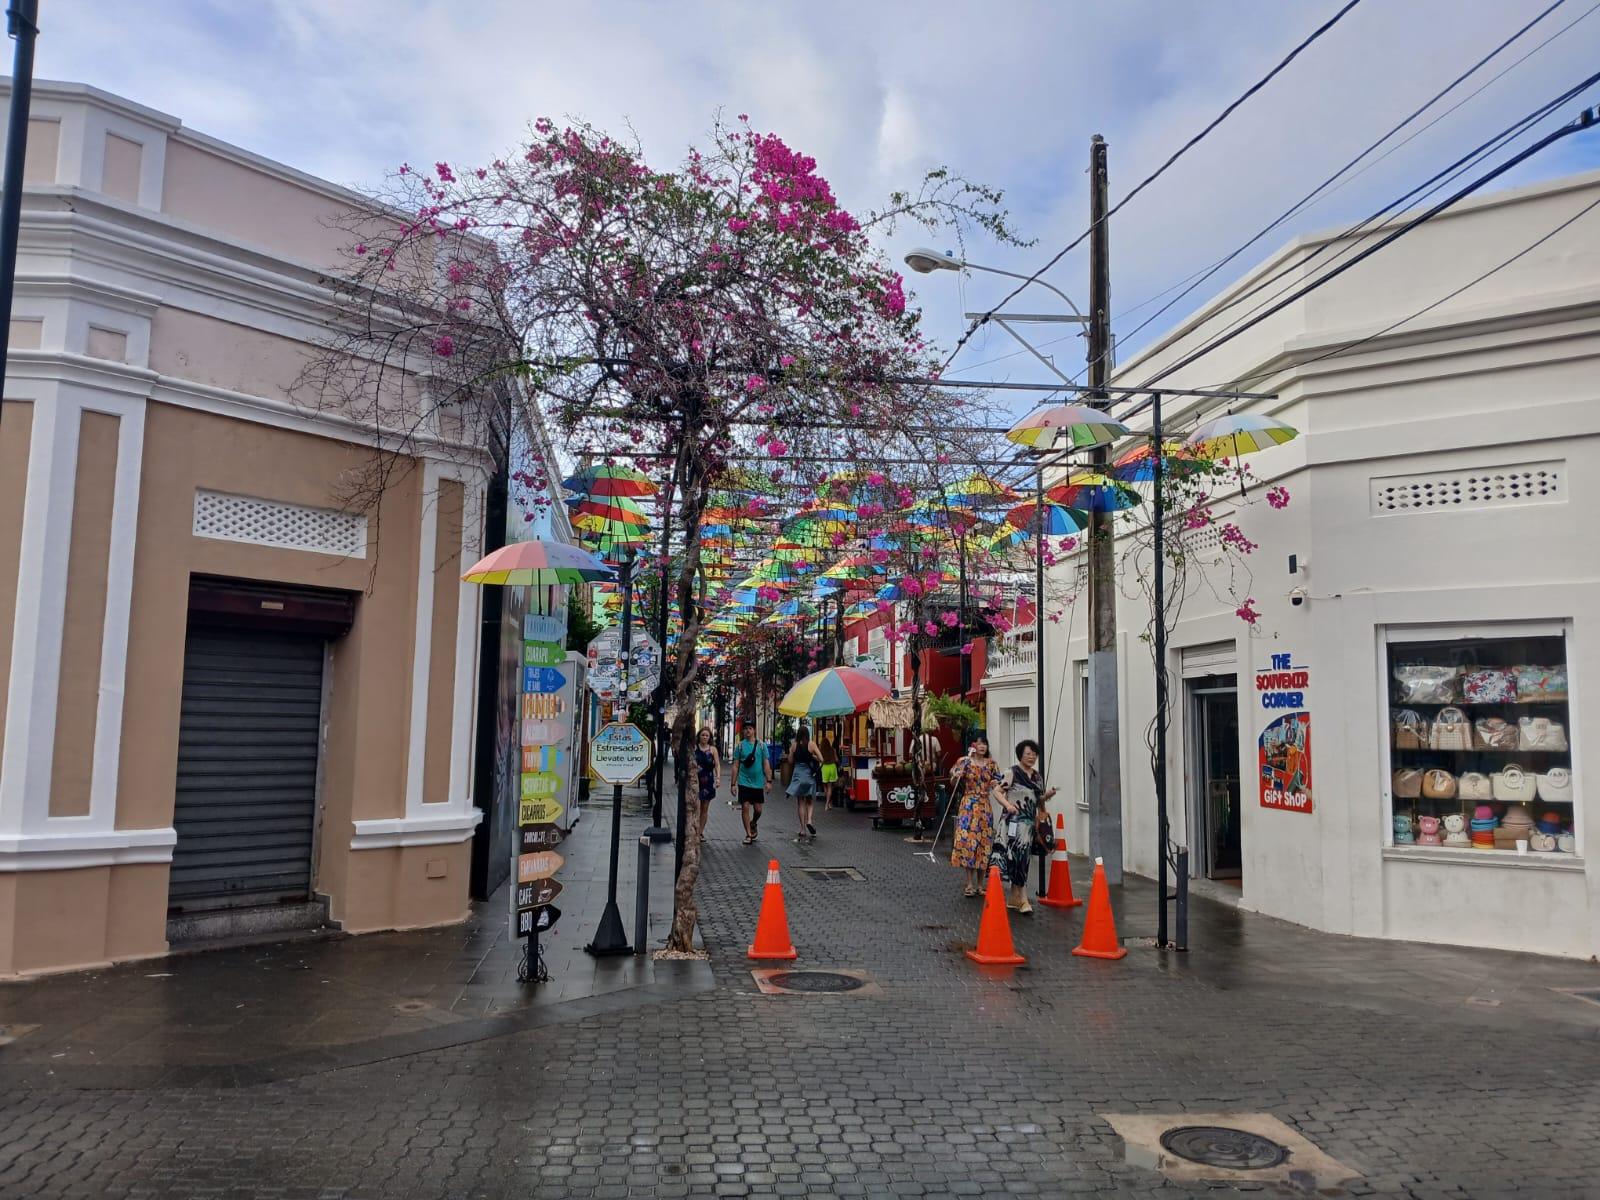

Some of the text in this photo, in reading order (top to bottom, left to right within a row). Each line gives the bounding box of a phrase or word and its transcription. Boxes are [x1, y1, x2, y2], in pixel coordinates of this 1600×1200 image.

[1271, 653, 1291, 670] THE
[1256, 672, 1309, 690] SOUVENIR
[1261, 691, 1304, 709] CORNER
[596, 744, 644, 752] Estresado?
[522, 804, 546, 821] CIGARROS
[520, 911, 533, 933] BBQ
